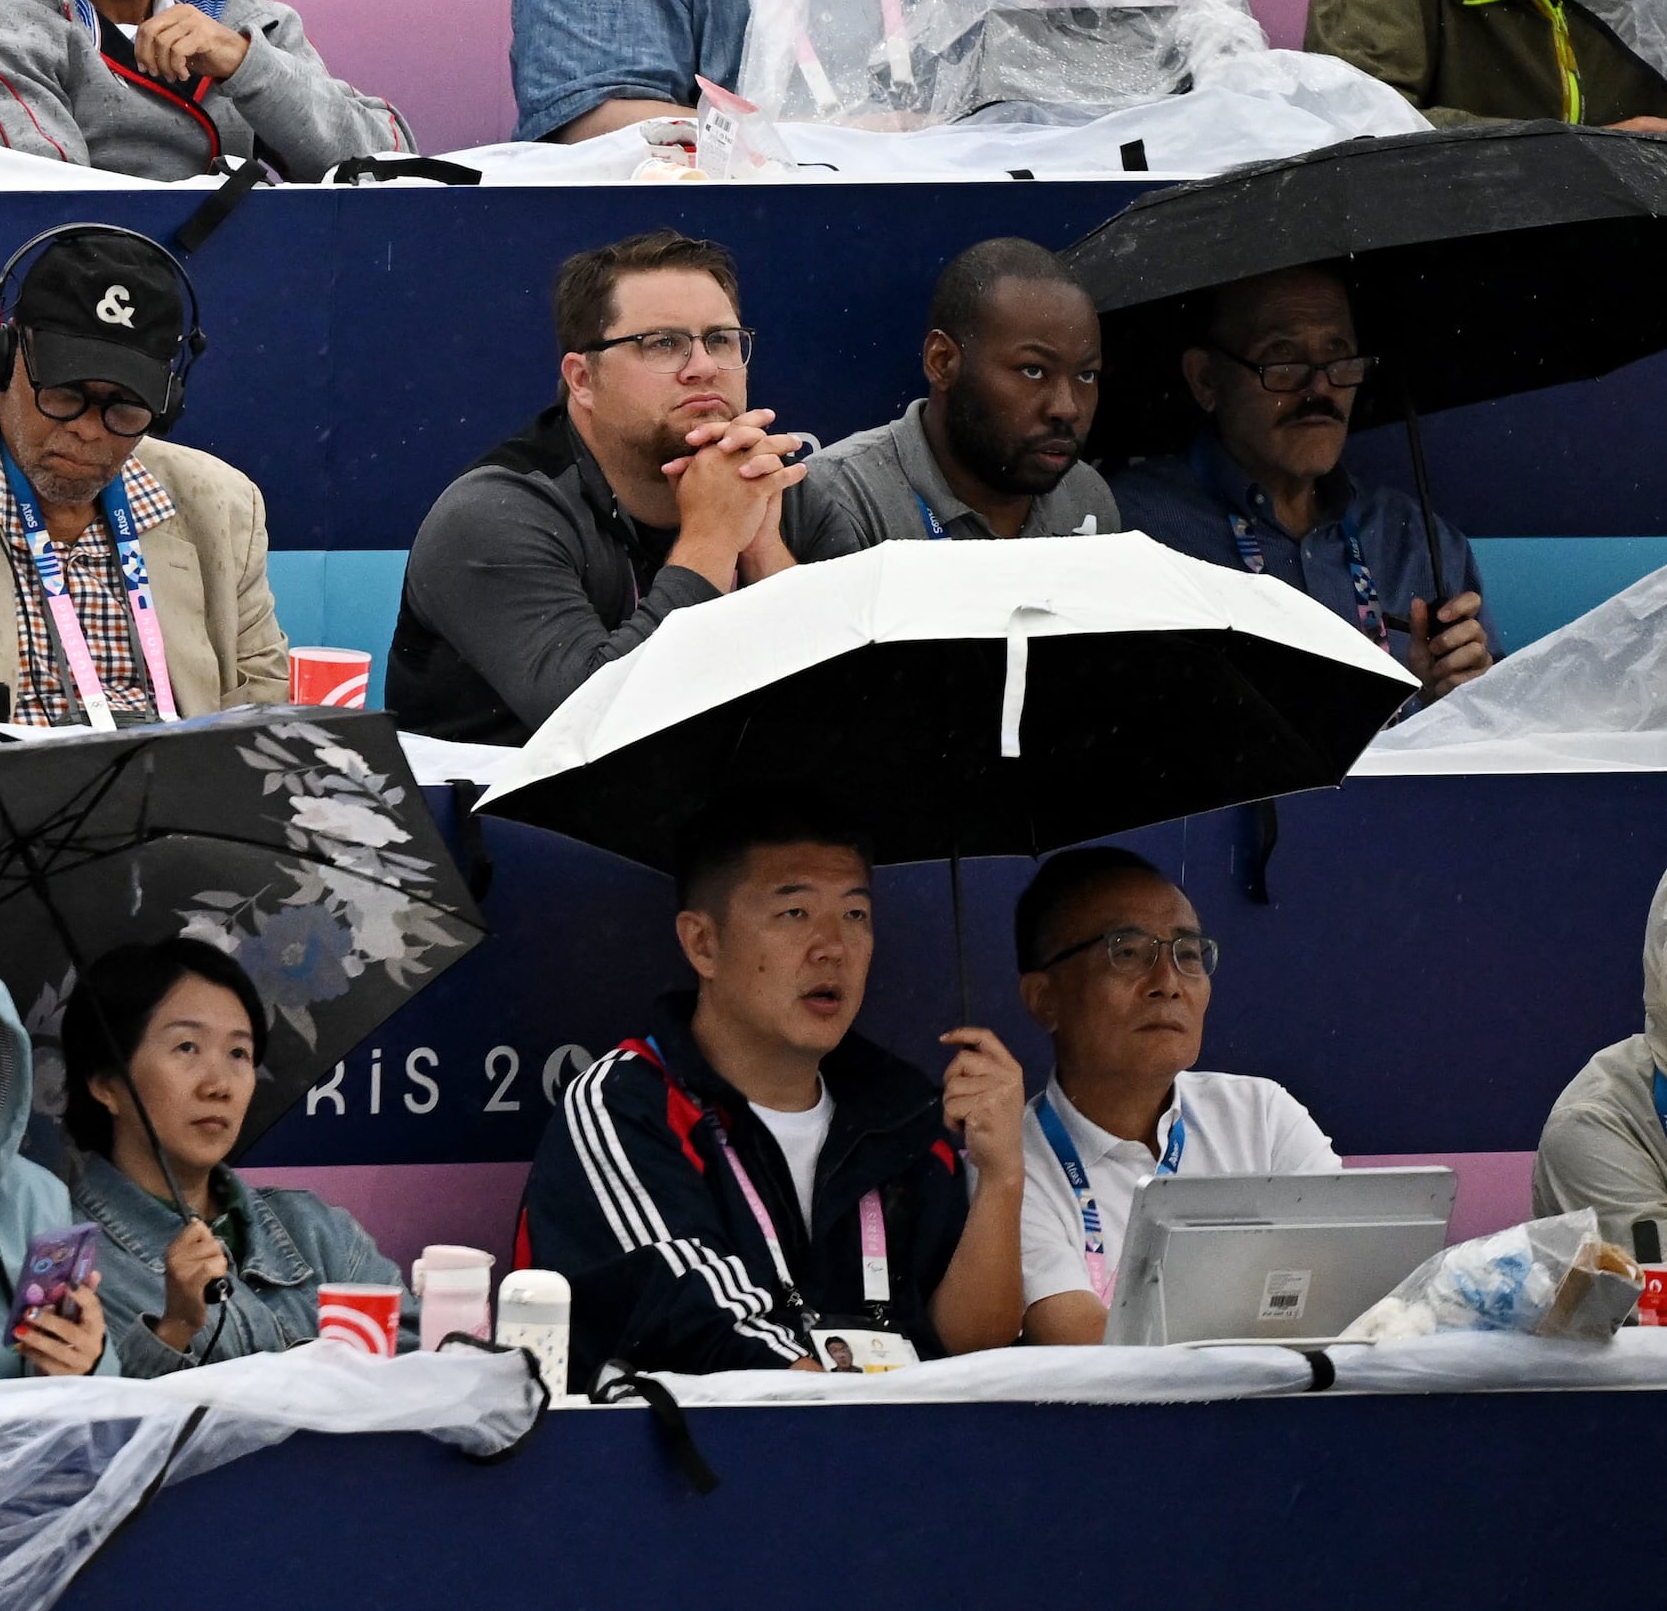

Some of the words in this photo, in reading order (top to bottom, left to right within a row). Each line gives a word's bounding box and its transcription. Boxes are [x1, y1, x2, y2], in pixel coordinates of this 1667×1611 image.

[20, 503, 38, 534] Atos
[114, 508, 131, 536] Atos
[1063, 1161, 1083, 1186] Atos
